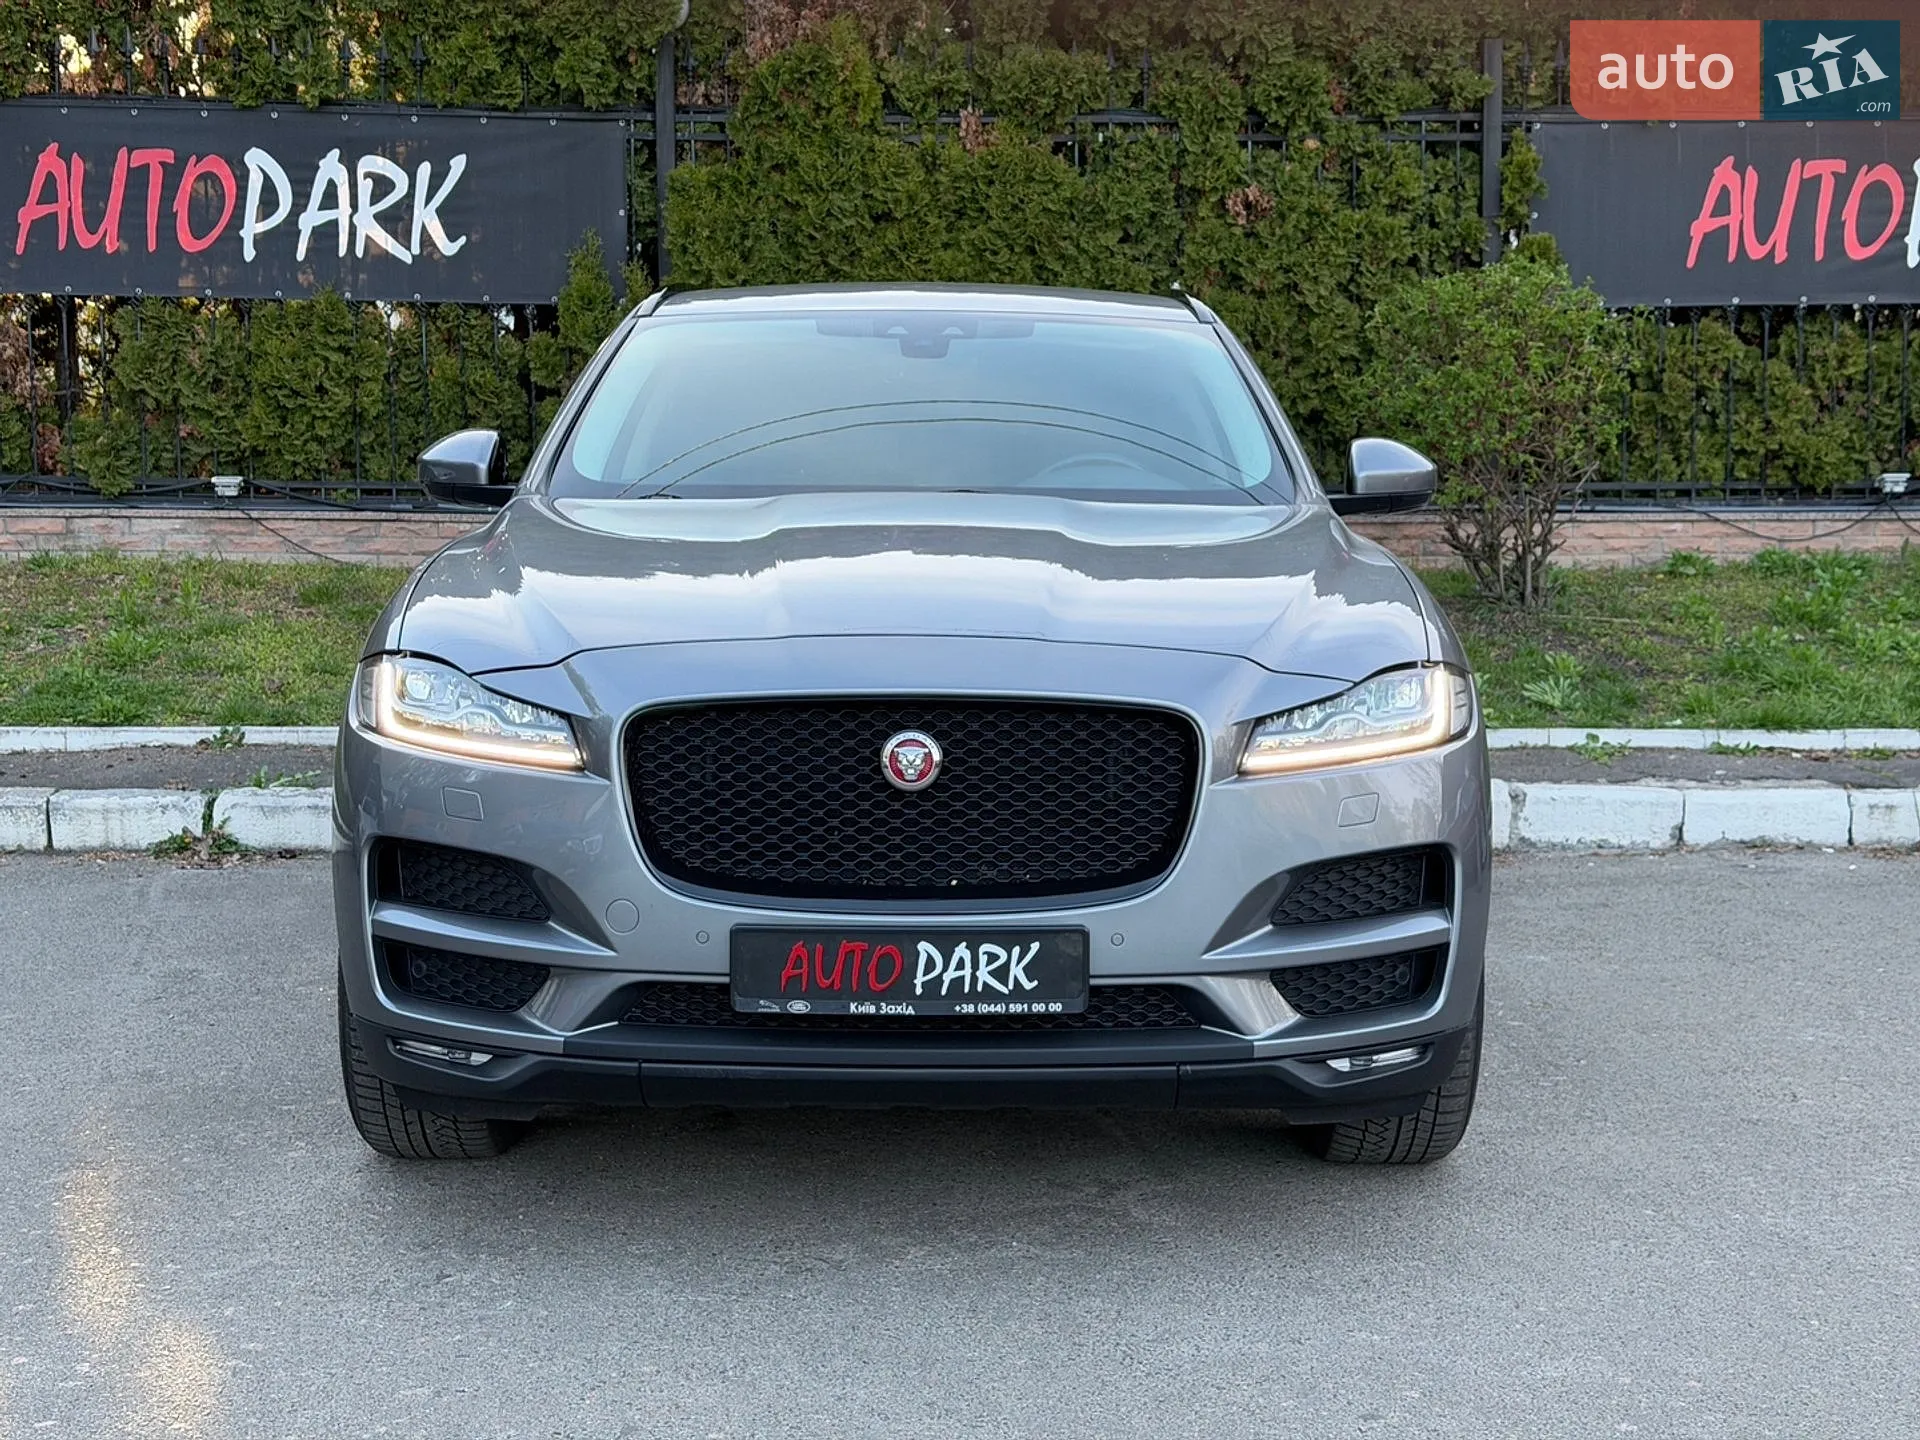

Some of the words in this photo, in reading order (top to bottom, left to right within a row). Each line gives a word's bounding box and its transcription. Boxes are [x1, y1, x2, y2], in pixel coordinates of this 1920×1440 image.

[850, 1001, 876, 1014] Київ
[880, 1002, 915, 1016] Захід
[954, 1003, 974, 1013] +38
[977, 1002, 1006, 1014] (044)
[1008, 1003, 1028, 1013] 591
[1032, 1002, 1045, 1012] 00
[1048, 1002, 1062, 1012] 00
